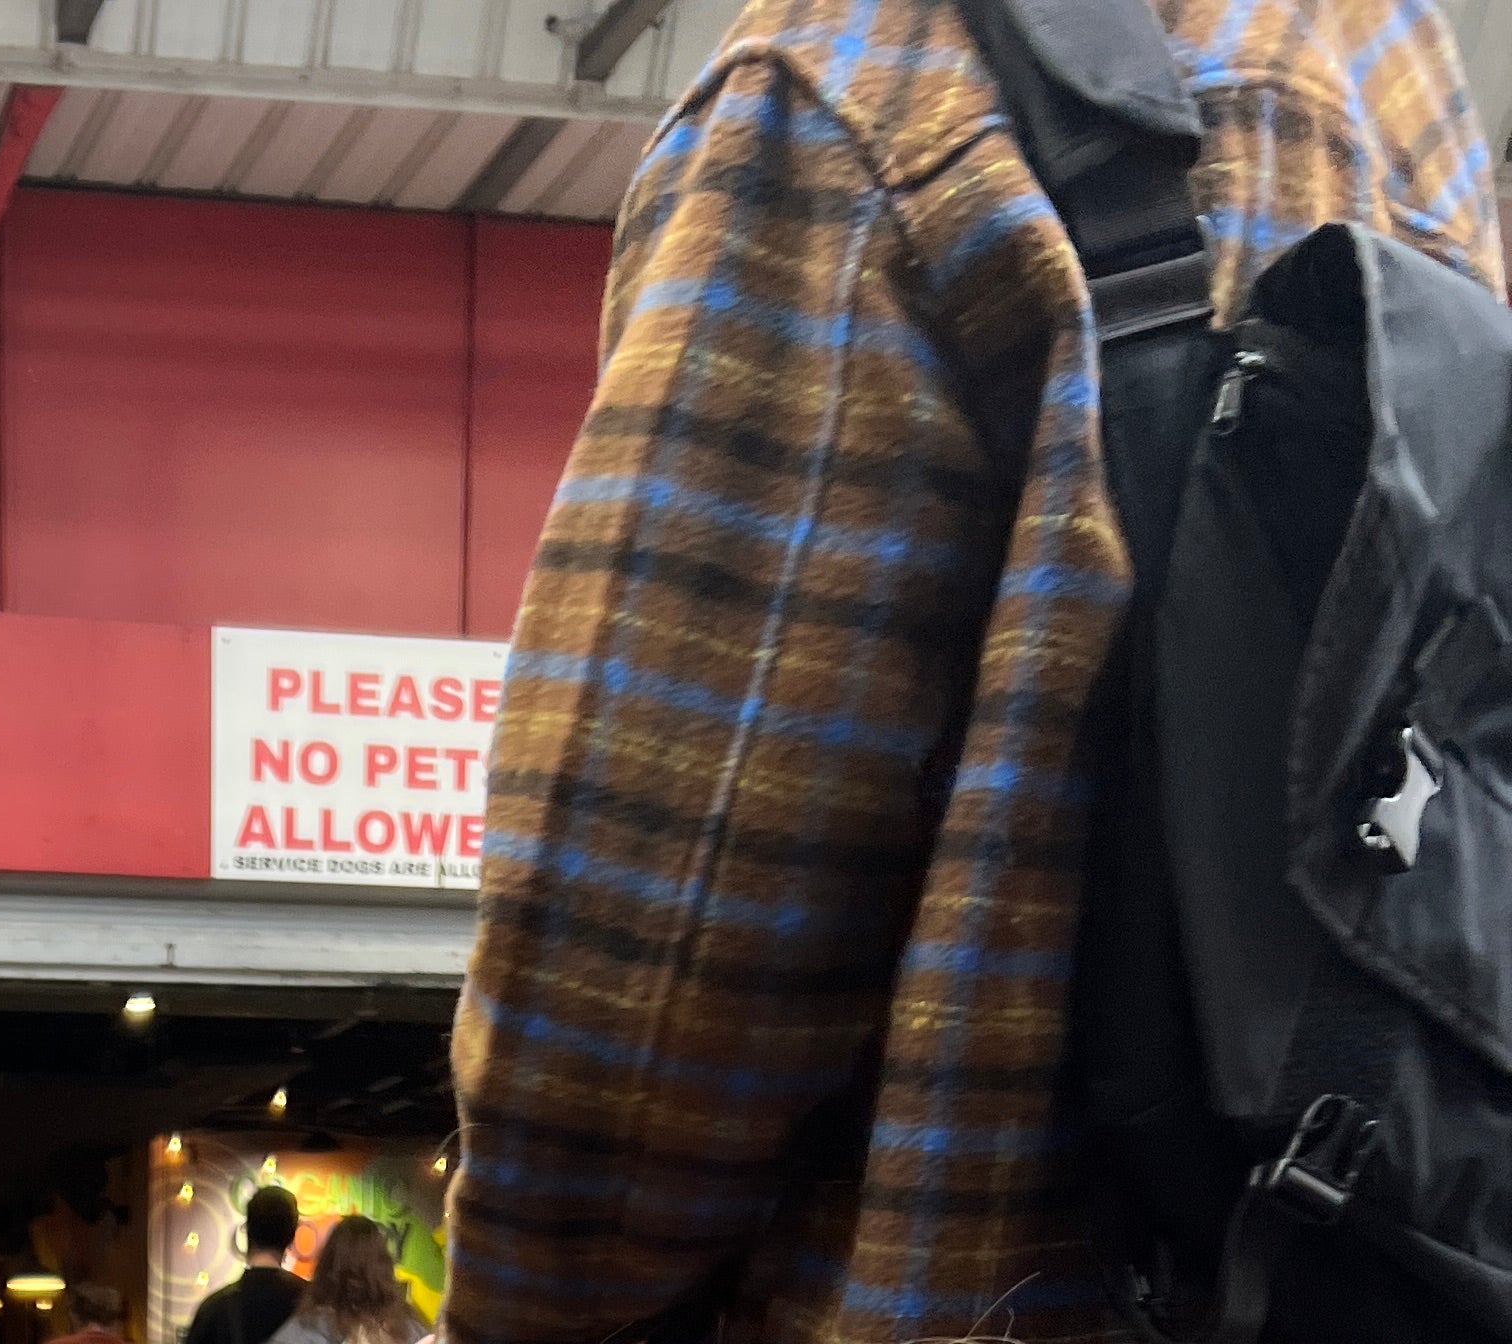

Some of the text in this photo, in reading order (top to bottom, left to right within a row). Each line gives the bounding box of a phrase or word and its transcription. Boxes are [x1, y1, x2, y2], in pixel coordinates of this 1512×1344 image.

[267, 667, 502, 722] PLEASE
[251, 738, 488, 791] NO PET
[235, 804, 486, 857] ALLOWE
[233, 856, 323, 873] SERVICE
[326, 858, 383, 875] DOGS
[389, 861, 433, 877] ARE
[231, 1172, 404, 1217] OGANIC
